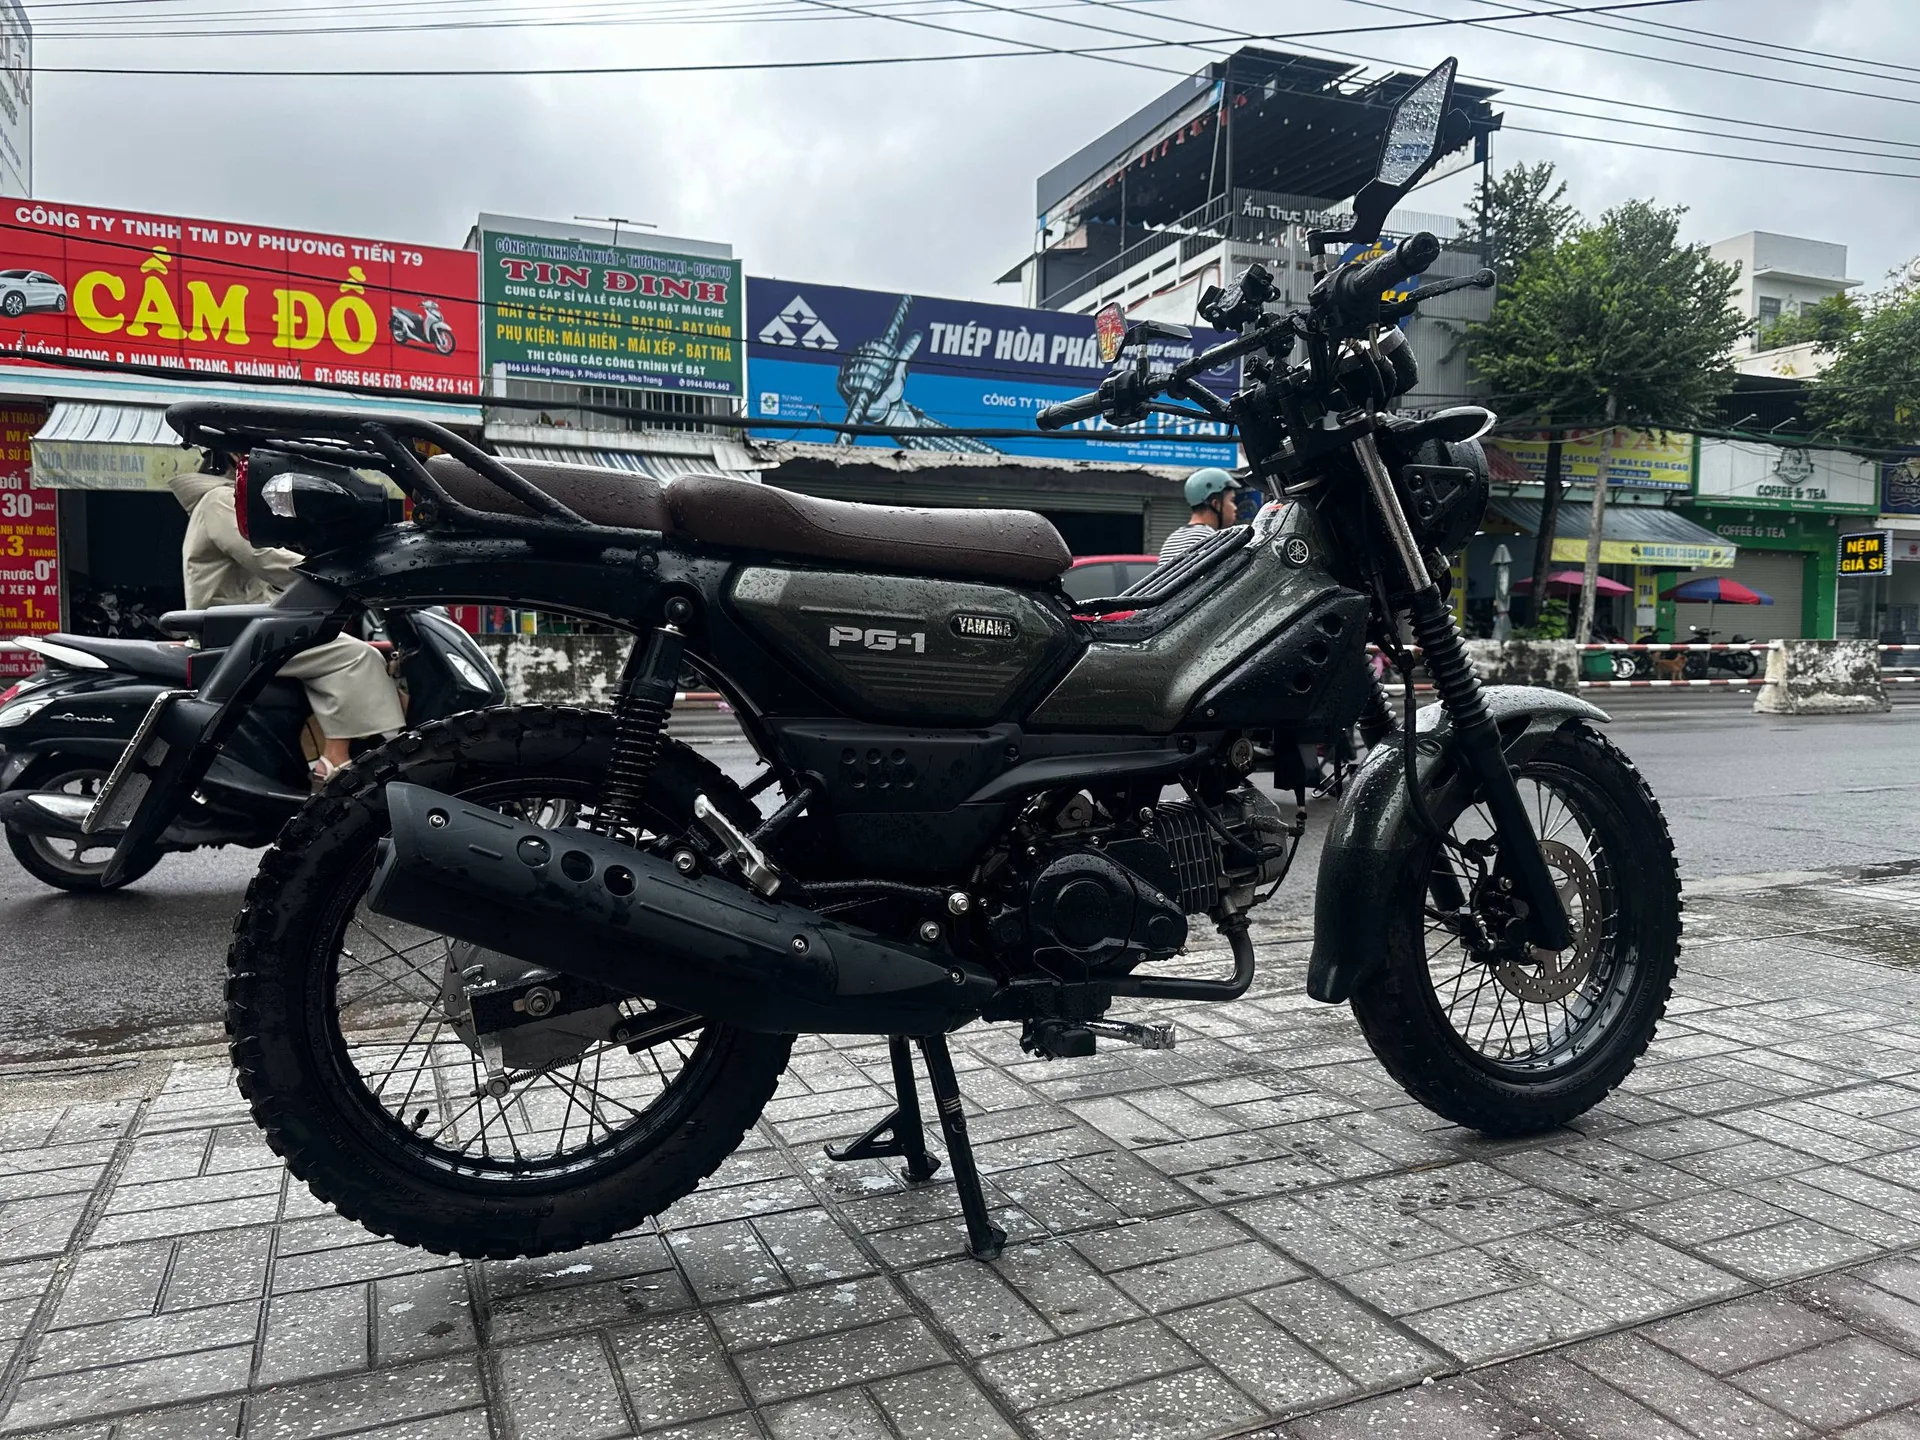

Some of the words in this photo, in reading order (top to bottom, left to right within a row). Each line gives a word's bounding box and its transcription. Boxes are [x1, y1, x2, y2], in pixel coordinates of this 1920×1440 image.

[15, 205, 80, 229] CÔNG
[87, 215, 115, 232] TY
[122, 219, 182, 239] TNHH
[188, 226, 218, 243] TM
[225, 230, 252, 246] DV
[258, 234, 346, 258] PHƯƠNG
[351, 242, 395, 263] TIẾN
[401, 251, 423, 266] 79
[526, 242, 540, 257] TY
[541, 244, 569, 260] TNHH
[499, 257, 592, 289] TIN
[72, 246, 250, 345] CẦM
[271, 265, 378, 355] ĐỒ
[497, 301, 524, 319] MAY
[527, 304, 536, 320] &
[504, 285, 536, 297] CUNG
[538, 287, 561, 300] CẤP
[577, 291, 592, 304] VÀ
[609, 296, 631, 308] CÁC
[633, 300, 657, 312] LOẠI
[659, 302, 680, 314] BẠT
[681, 304, 702, 316] MÁI
[703, 308, 724, 318] CHE
[496, 324, 522, 344] PHỤ
[525, 325, 559, 346] KIỆN:
[561, 329, 585, 348] MÁI
[588, 332, 617, 350] HIÊN
[627, 334, 651, 354] MÁI
[653, 337, 676, 356] XẾP
[686, 343, 708, 362] BẠT
[710, 343, 732, 362] THẢ
[929, 320, 993, 358] THÉP
[994, 325, 1046, 363] HÒA
[1048, 333, 1106, 369] PHÁ
[527, 349, 545, 361] THI
[547, 351, 578, 364] CÔNG
[580, 354, 603, 365] CÁC
[605, 356, 635, 369] CÔNG
[636, 359, 669, 372] TRÌNH
[686, 365, 706, 378] BẠT
[234, 358, 275, 378] KHÁNH
[277, 361, 301, 380] HÒA
[335, 371, 360, 386] 0565
[362, 372, 381, 387] 645
[383, 374, 402, 388] 678
[410, 376, 434, 391] 0942
[436, 378, 454, 393] 474
[457, 380, 474, 395] 141
[982, 392, 1017, 407] CÔNG
[1018, 397, 1033, 408] TY
[102, 454, 117, 472] XE
[120, 450, 145, 473] MÁY
[1756, 485, 1794, 499] COFFEE
[1795, 487, 1804, 499] &
[1806, 488, 1827, 500] TEA
[2, 493, 33, 518] 30
[1717, 524, 1753, 537] COFFEE
[1755, 527, 1763, 537] &
[1766, 527, 1786, 538] TEA
[7, 535, 24, 557] 3
[1846, 537, 1879, 555] NỆM
[1842, 556, 1865, 571] GIÁ
[958, 616, 1012, 637] YAMAHA
[829, 625, 926, 653] PG-1
